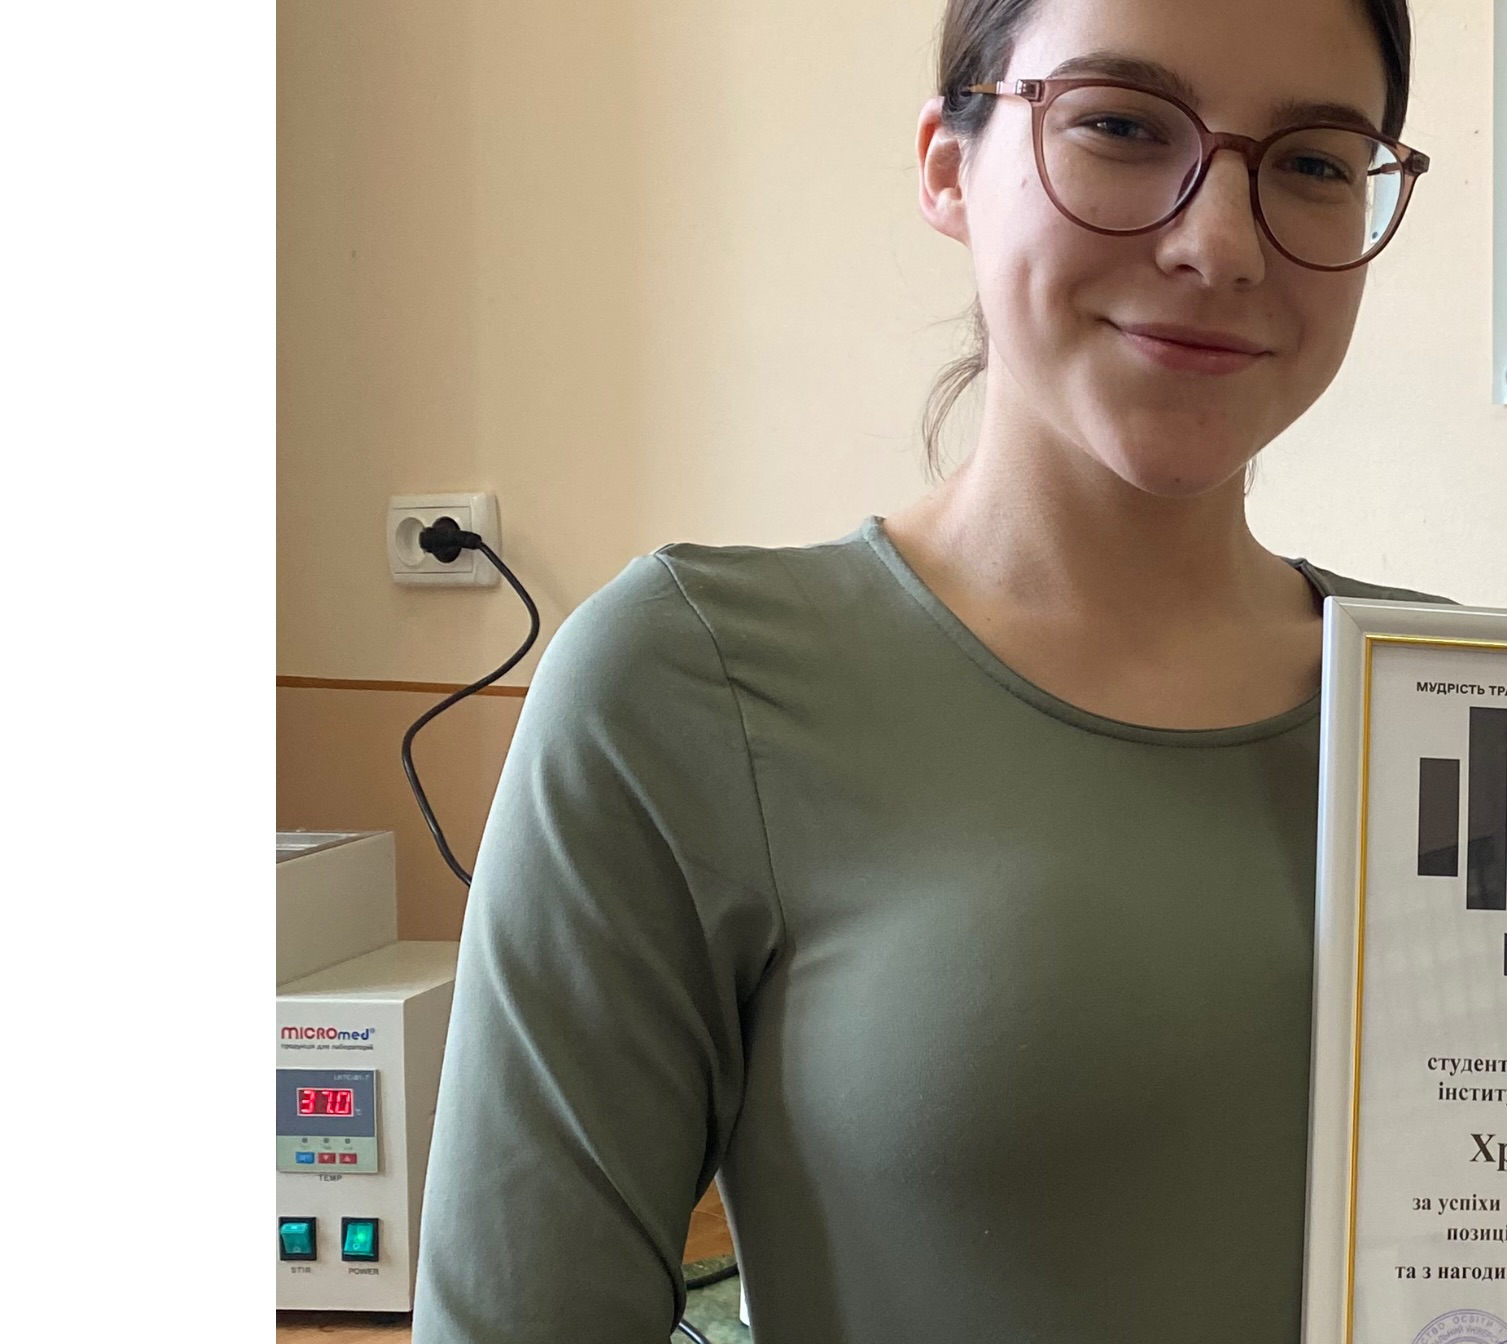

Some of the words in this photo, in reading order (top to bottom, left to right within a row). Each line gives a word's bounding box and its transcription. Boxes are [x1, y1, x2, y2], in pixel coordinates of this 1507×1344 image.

[1416, 681, 1485, 696] МУДРІСТЬ
[319, 1174, 343, 1182] TEMP
[1412, 1197, 1431, 1211] за
[1438, 1194, 1500, 1215] успіхи
[290, 1266, 311, 1274] STIR
[1395, 1265, 1416, 1280] та
[1422, 1266, 1431, 1280] з
[1438, 1266, 1506, 1282] нагоди
